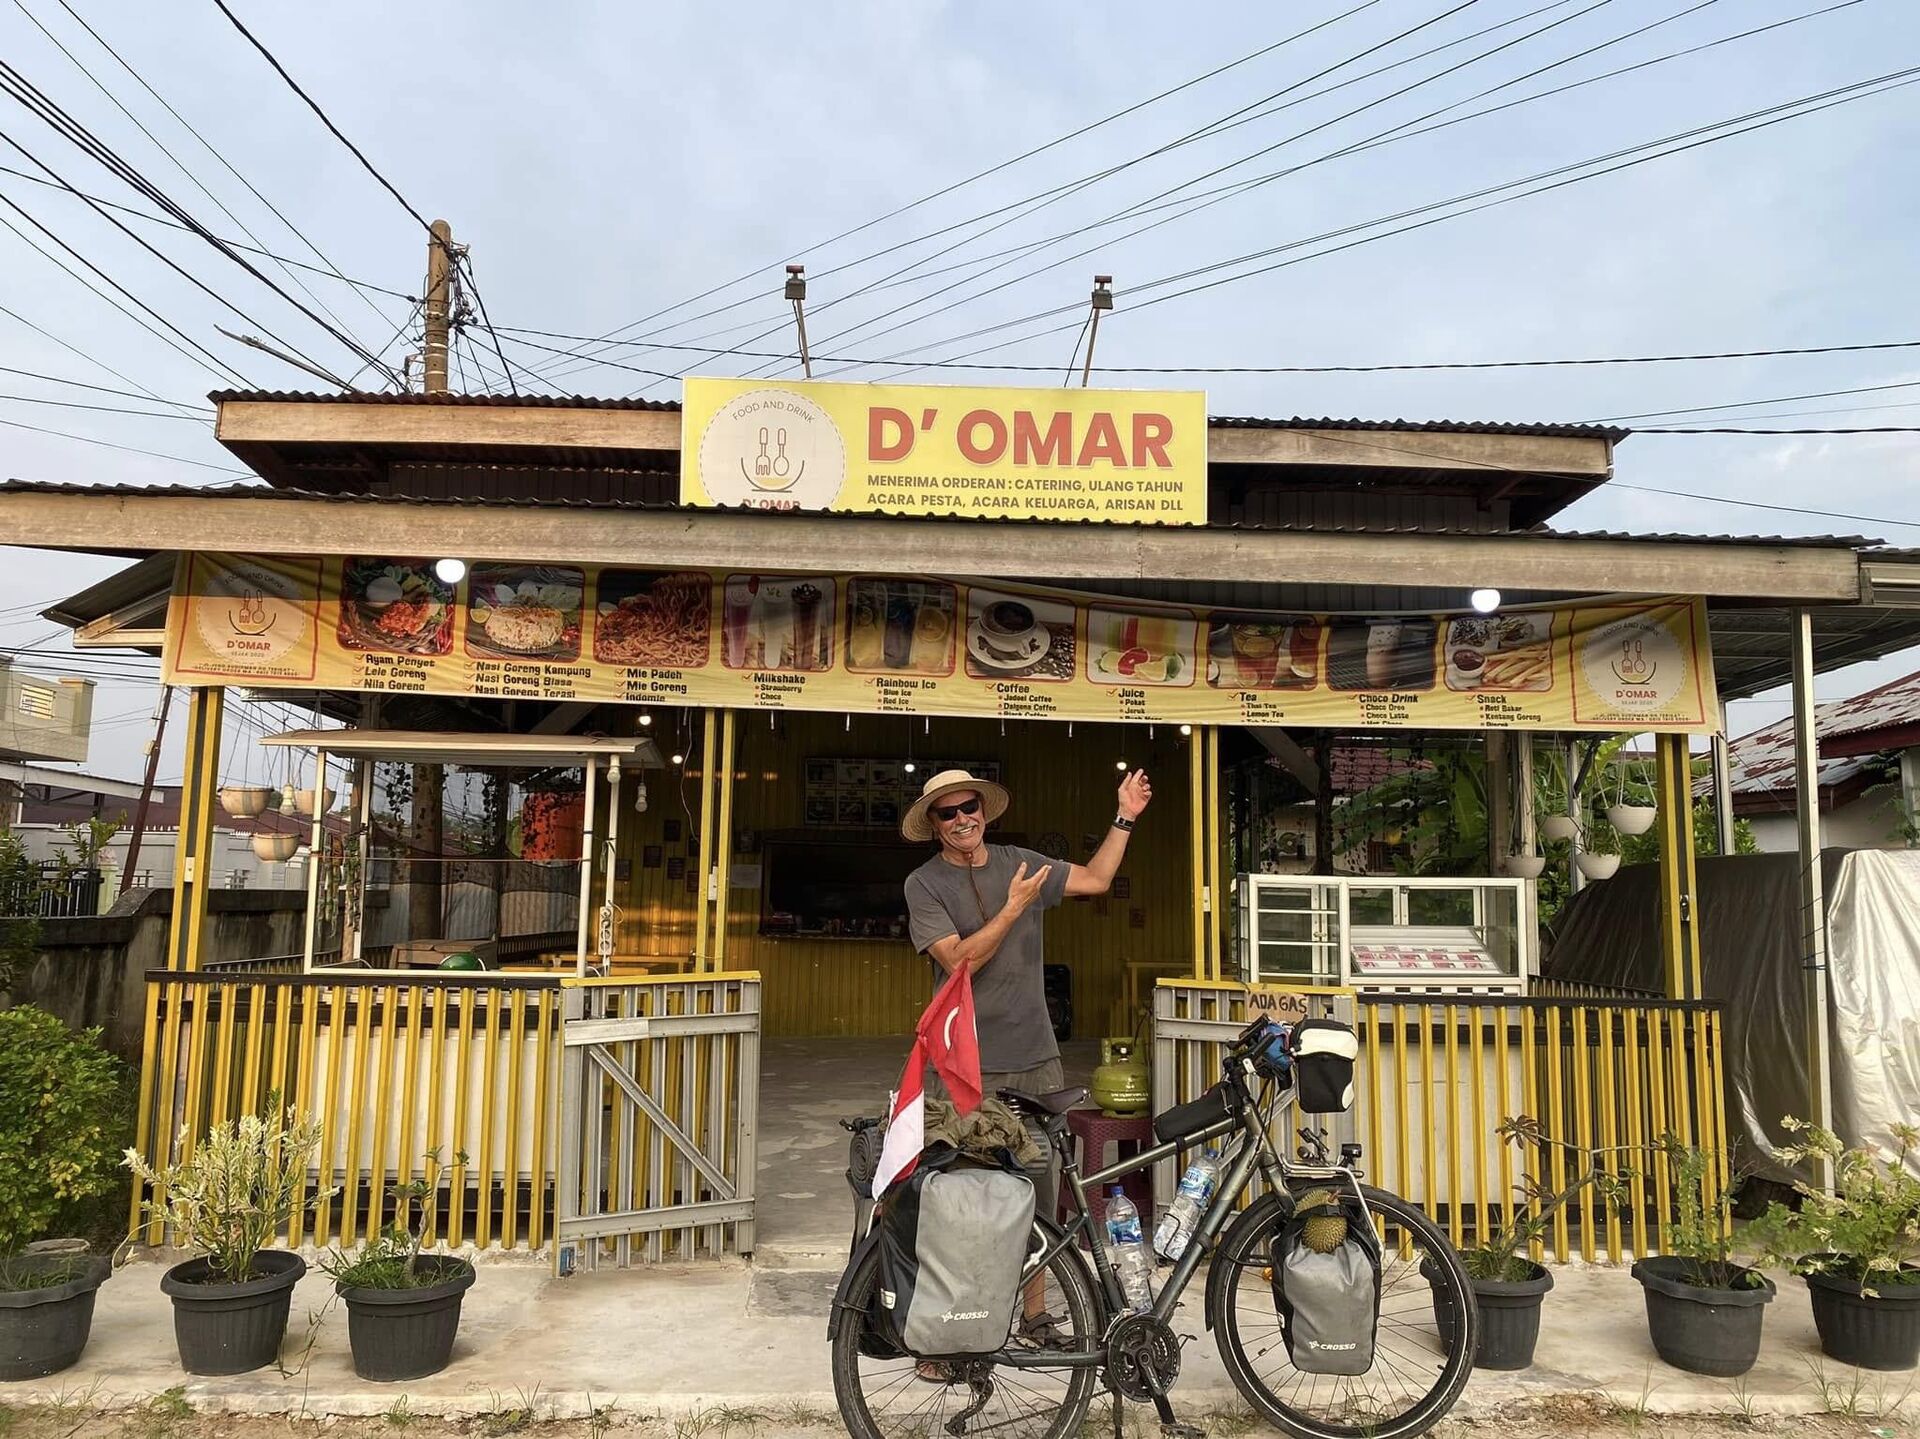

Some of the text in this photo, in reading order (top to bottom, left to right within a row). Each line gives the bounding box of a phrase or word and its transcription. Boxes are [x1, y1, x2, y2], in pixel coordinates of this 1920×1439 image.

[732, 400, 816, 423] FOOD AND DRINK
[956, 408, 1174, 468] OMAR
[867, 475, 939, 488] MENERIMA
[942, 477, 1006, 490] ORDERAN
[1015, 479, 1086, 492] CATERING,
[1088, 480, 1134, 492] ULANG
[1137, 481, 1183, 493] TAHUN
[867, 493, 1183, 511] ACARA PESTA, ACARA KELUARGA, ARISAN DLL
[227, 640, 271, 651] D'OMAR
[365, 653, 436, 668] Ayam Penyet
[364, 666, 427, 681] Lele Goreng
[476, 661, 592, 678] Nasi Goreng Kampung
[627, 668, 682, 679] Mie Padeh
[475, 673, 573, 687] Nasi Goreng Biasa
[753, 672, 806, 684] Milkshake
[876, 677, 937, 689] Rainbow Ice
[363, 679, 385, 689] Nila
[627, 680, 687, 694] Mie Goreng
[760, 683, 803, 693] Strawberry
[997, 683, 1030, 693] Coffee
[475, 685, 498, 695] Nasi
[544, 688, 576, 698] Terasi
[760, 692, 782, 700] Choco
[883, 688, 899, 696] Blue
[1118, 688, 1145, 698] Juice
[1239, 692, 1257, 701] Tea
[1615, 689, 1658, 699] D'OMAR
[626, 692, 666, 702] Indomie
[1028, 695, 1052, 703] Coffee
[1359, 694, 1419, 703] Choco Drink
[1476, 694, 1507, 704] Snack
[1033, 703, 1057, 711] Coffee
[1365, 703, 1387, 711] Choco
[1246, 710, 1270, 718] Lemon
[1485, 713, 1541, 722] Kentang Goreng
[1249, 993, 1307, 1014] ADA GAS
[953, 1310, 989, 1321] CROSSO
[1320, 1342, 1357, 1351] CROSSO
